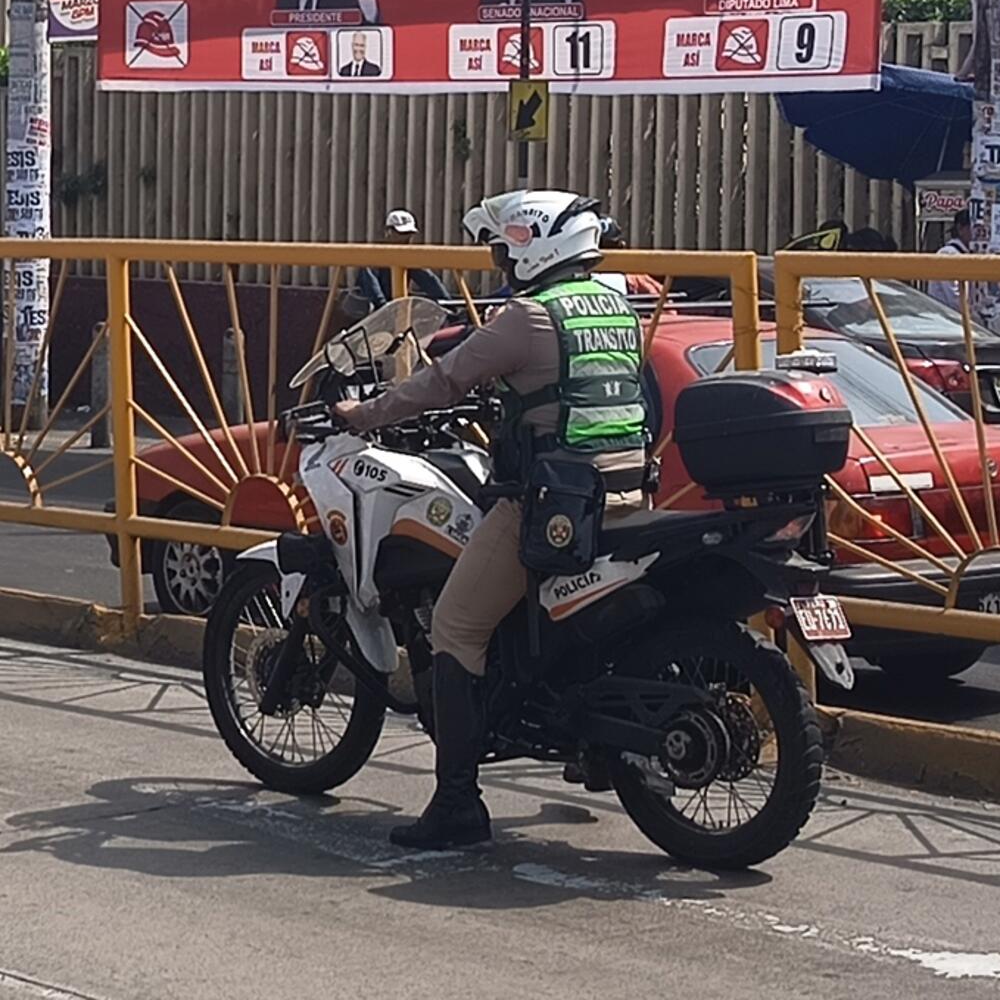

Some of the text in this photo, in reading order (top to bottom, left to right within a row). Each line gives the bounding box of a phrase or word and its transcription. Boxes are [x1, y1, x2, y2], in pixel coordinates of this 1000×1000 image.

[288, 13, 342, 22] PRESIDENTE
[251, 41, 281, 54] MARCA
[459, 38, 491, 52] MARCA
[676, 33, 711, 47] MARCA
[795, 22, 816, 64] 9
[565, 31, 591, 69] 11
[258, 57, 273, 71] ASÍ
[467, 55, 482, 71] ASÍ
[683, 52, 700, 68] ASÍ
[559, 294, 630, 317] POLICIA
[573, 328, 636, 352] TRANSITO
[365, 464, 388, 482] 105
[554, 571, 602, 600] POLICIA
